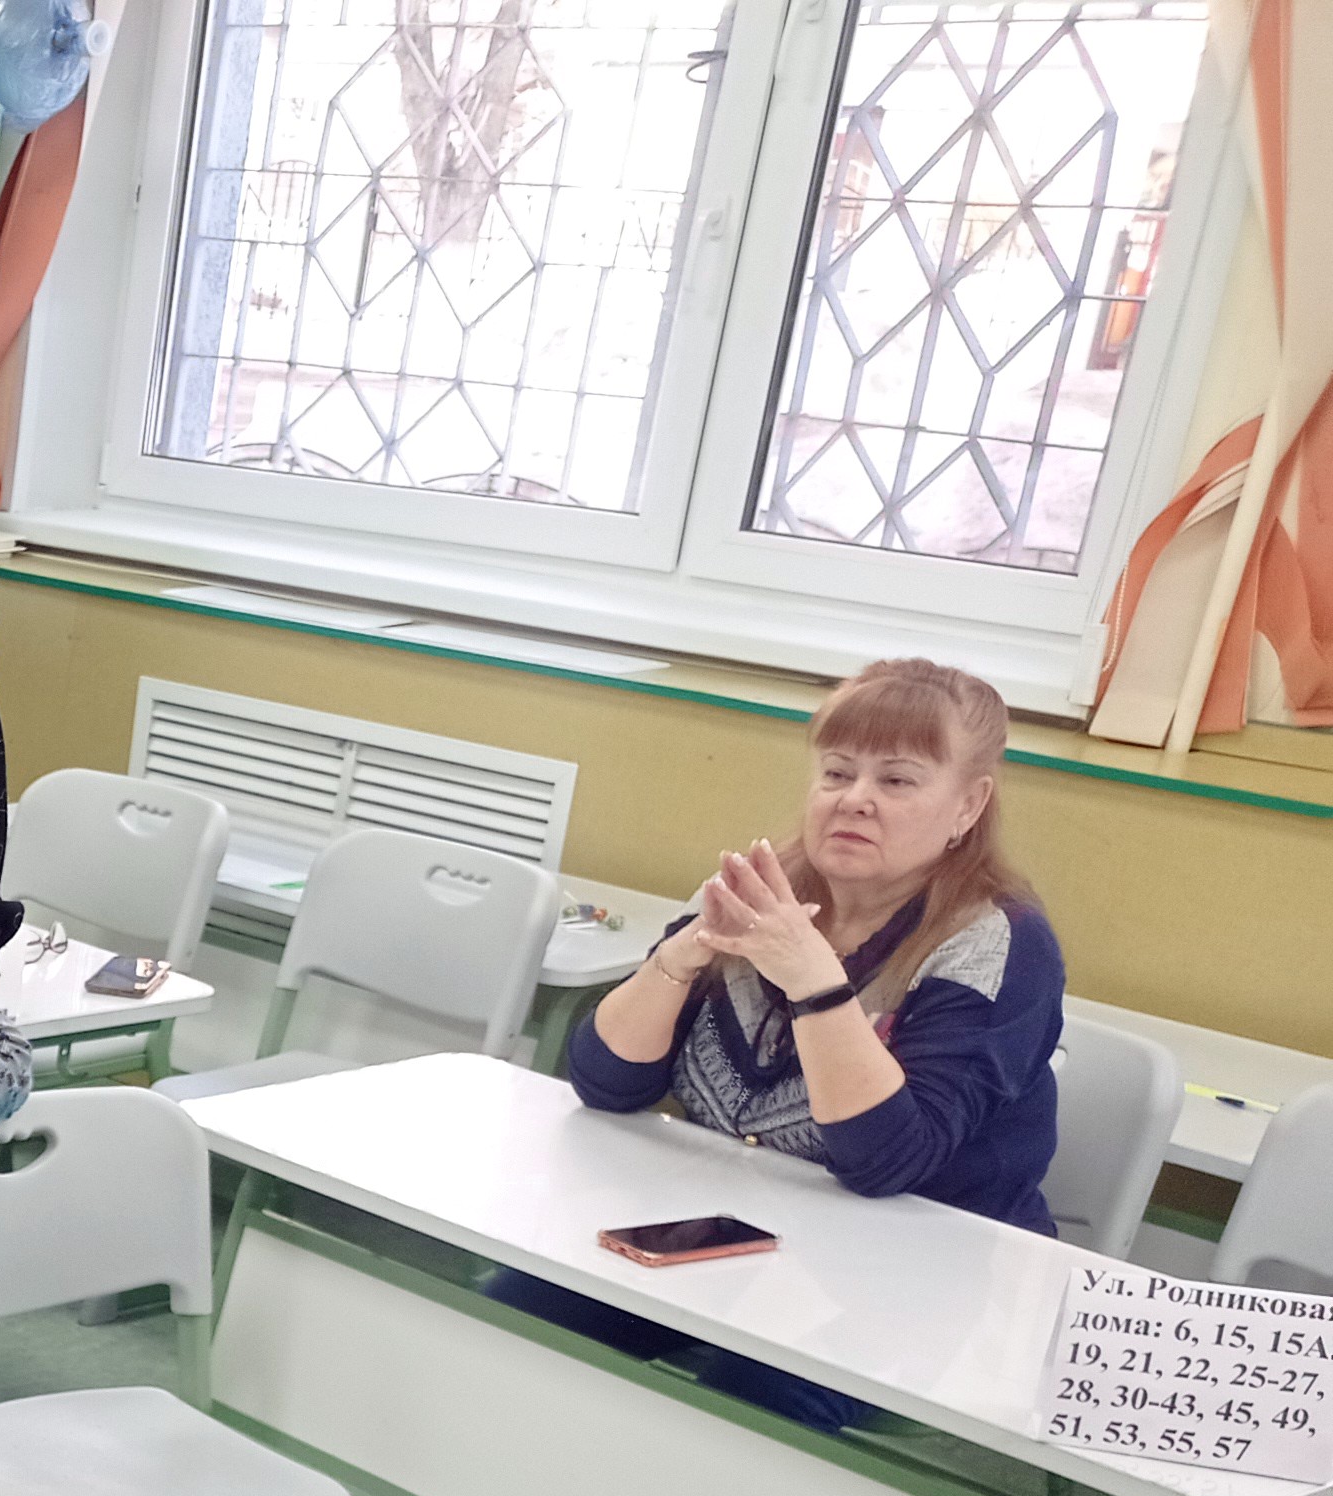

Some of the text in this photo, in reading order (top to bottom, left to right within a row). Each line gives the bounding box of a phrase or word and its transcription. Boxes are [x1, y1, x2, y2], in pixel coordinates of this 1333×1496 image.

[1083, 1268, 1134, 1298] Ул.
[1070, 1310, 1163, 1338] дома:
[1174, 1318, 1200, 1346] 6,
[1212, 1323, 1255, 1354] 15,
[1067, 1341, 1325, 1401] 19, 21, 22, 25-27,
[1057, 1377, 1317, 1438] 28, 30-43, 45, 49,
[1048, 1413, 1253, 1462] 51, 53, 55, 57
